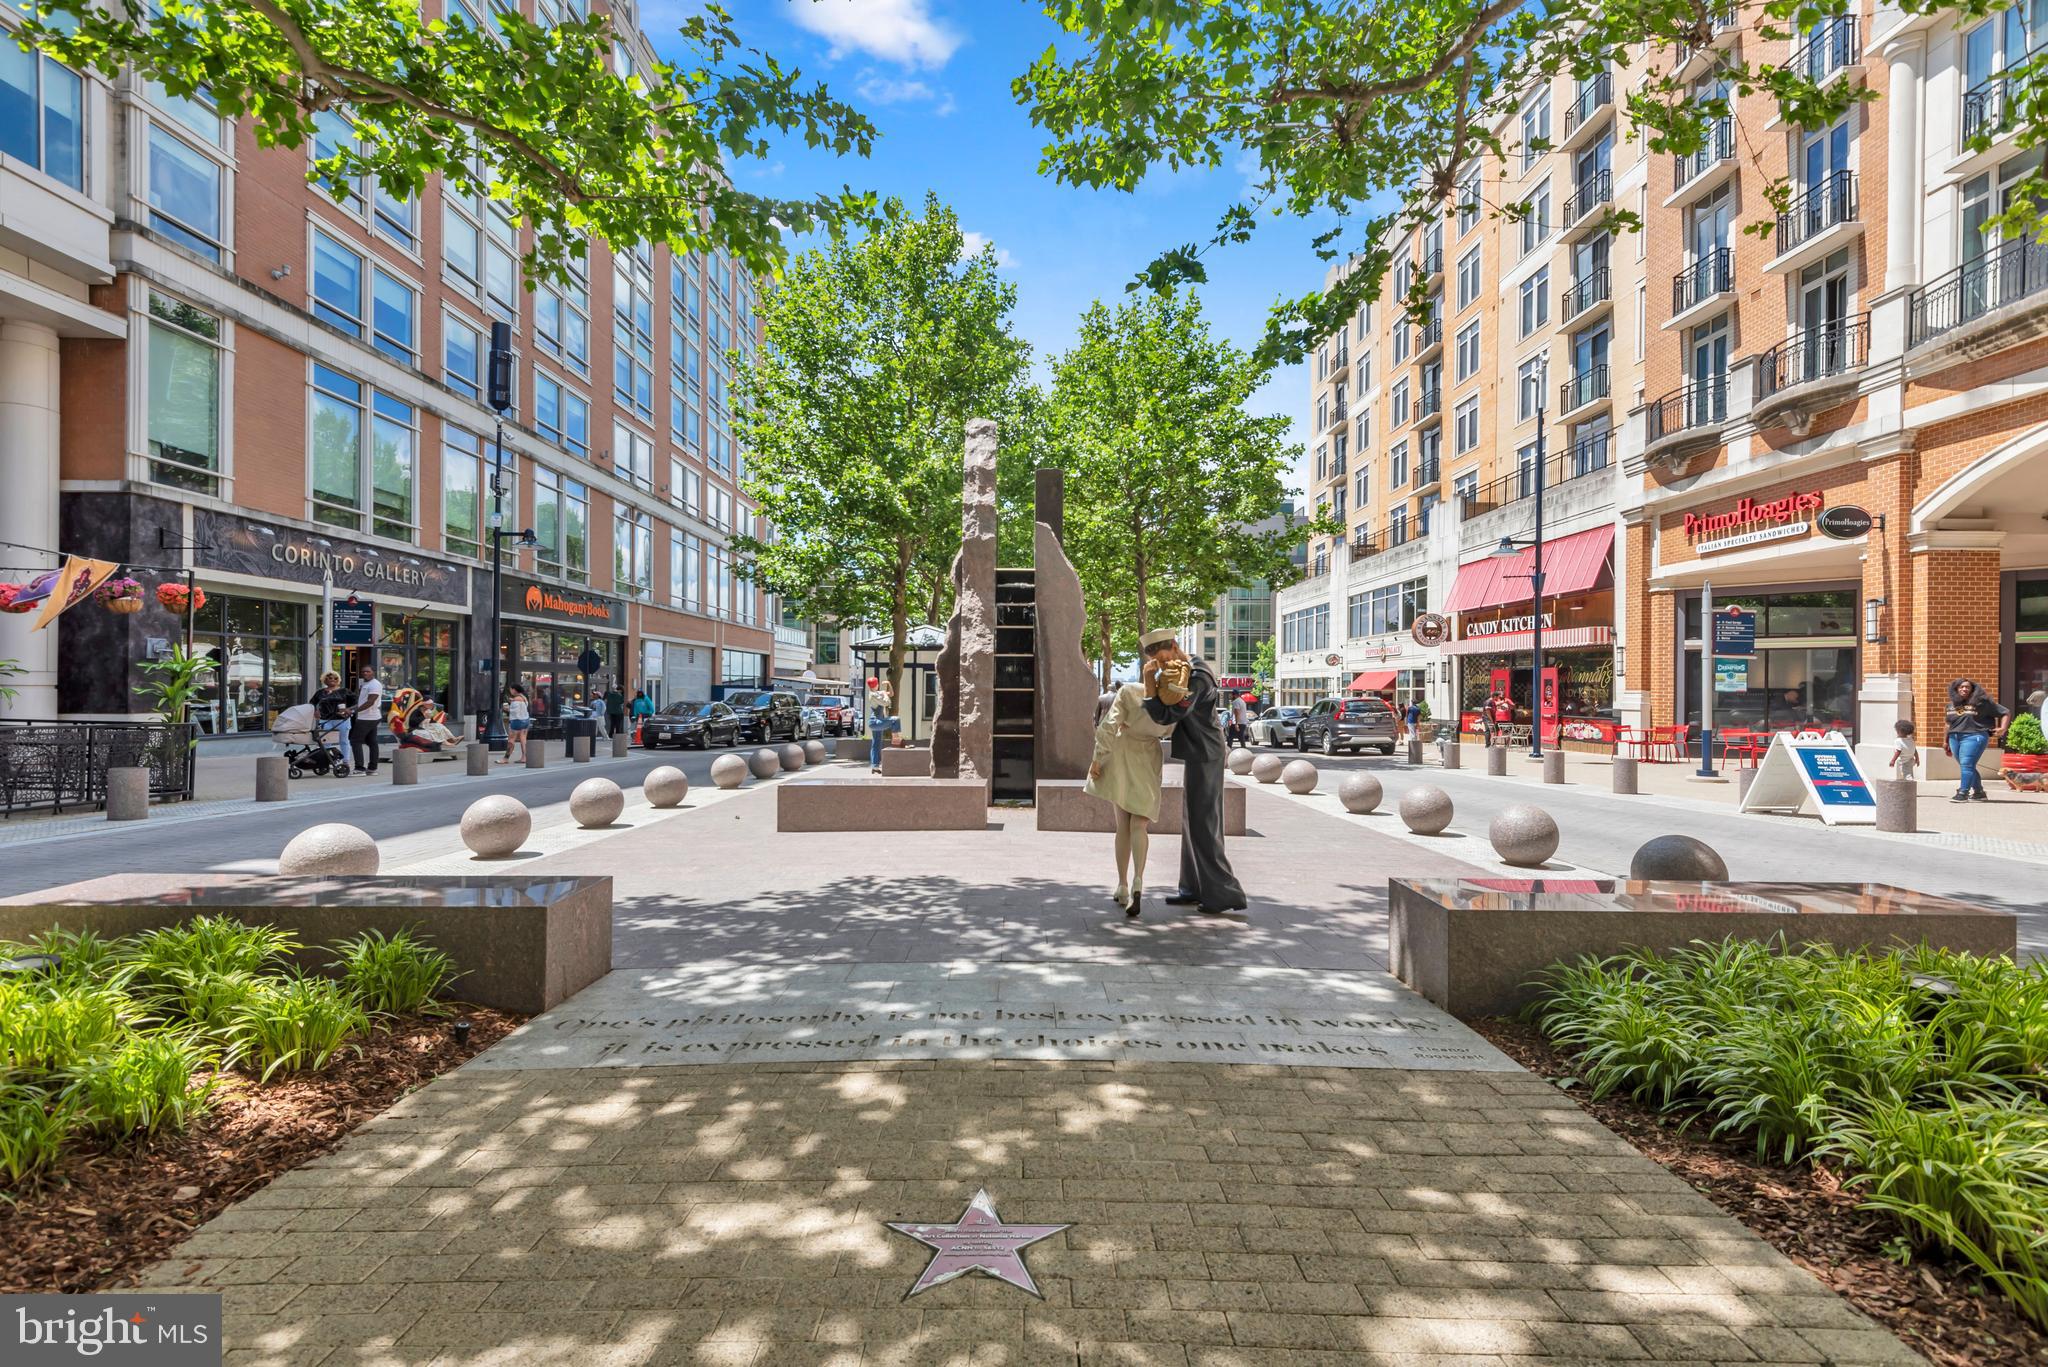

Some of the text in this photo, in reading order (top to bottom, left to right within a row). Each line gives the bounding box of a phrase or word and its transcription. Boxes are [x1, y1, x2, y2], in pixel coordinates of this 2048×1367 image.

[1684, 490, 1823, 537] PrimoHoagies
[1825, 517, 1871, 528] PrimoHoagies
[1698, 525, 1805, 552] ITALIAN SPECIALTY SANDWICHES
[272, 543, 428, 587] CORINTO GALLERY
[543, 593, 610, 618] MahoganyBooks
[1466, 620, 1499, 637] CANDY
[554, 1016, 658, 1030] One's
[664, 1011, 873, 1038] philosophy
[887, 1011, 917, 1021] is
[928, 1010, 984, 1021] not
[996, 1009, 1066, 1021] best
[1075, 1014, 1257, 1026] expressed
[1265, 1015, 1302, 1026] in
[598, 1042, 630, 1055] it
[641, 1041, 674, 1053] is
[680, 1035, 881, 1053] expressed
[892, 1035, 928, 1047] in
[943, 1034, 1003, 1047] the
[1014, 1034, 1163, 1048] choices
[1175, 1041, 1247, 1051] one
[1413, 1052, 1486, 1060] Roosevelt
